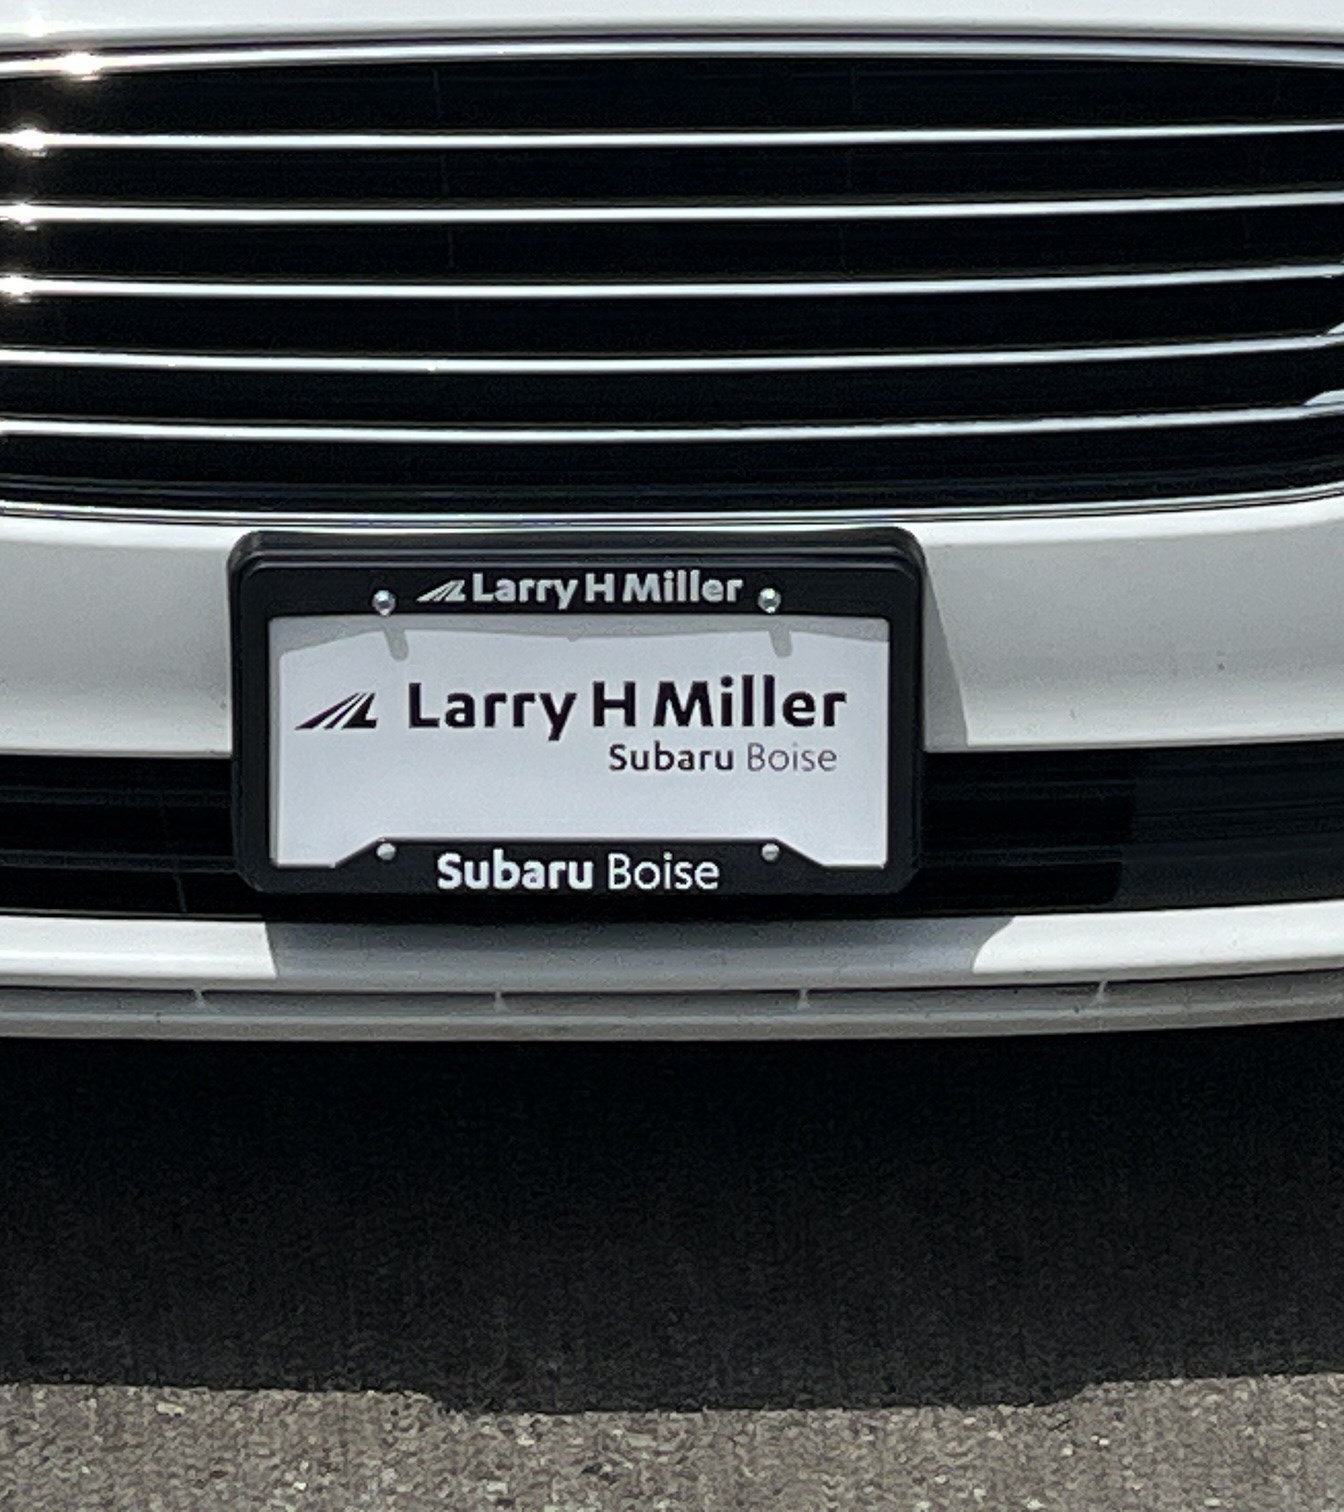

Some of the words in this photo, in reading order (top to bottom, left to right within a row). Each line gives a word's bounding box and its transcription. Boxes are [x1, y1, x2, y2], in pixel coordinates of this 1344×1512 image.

[472, 572, 577, 610] Larry
[584, 573, 615, 602] H
[622, 569, 743, 603] Miller
[407, 682, 578, 742] Larry
[591, 680, 638, 728] H
[652, 674, 848, 728] Miller
[608, 739, 735, 772] Subaru
[746, 742, 838, 773] Boise
[437, 848, 594, 890] Subaru
[607, 851, 720, 890] Boise
